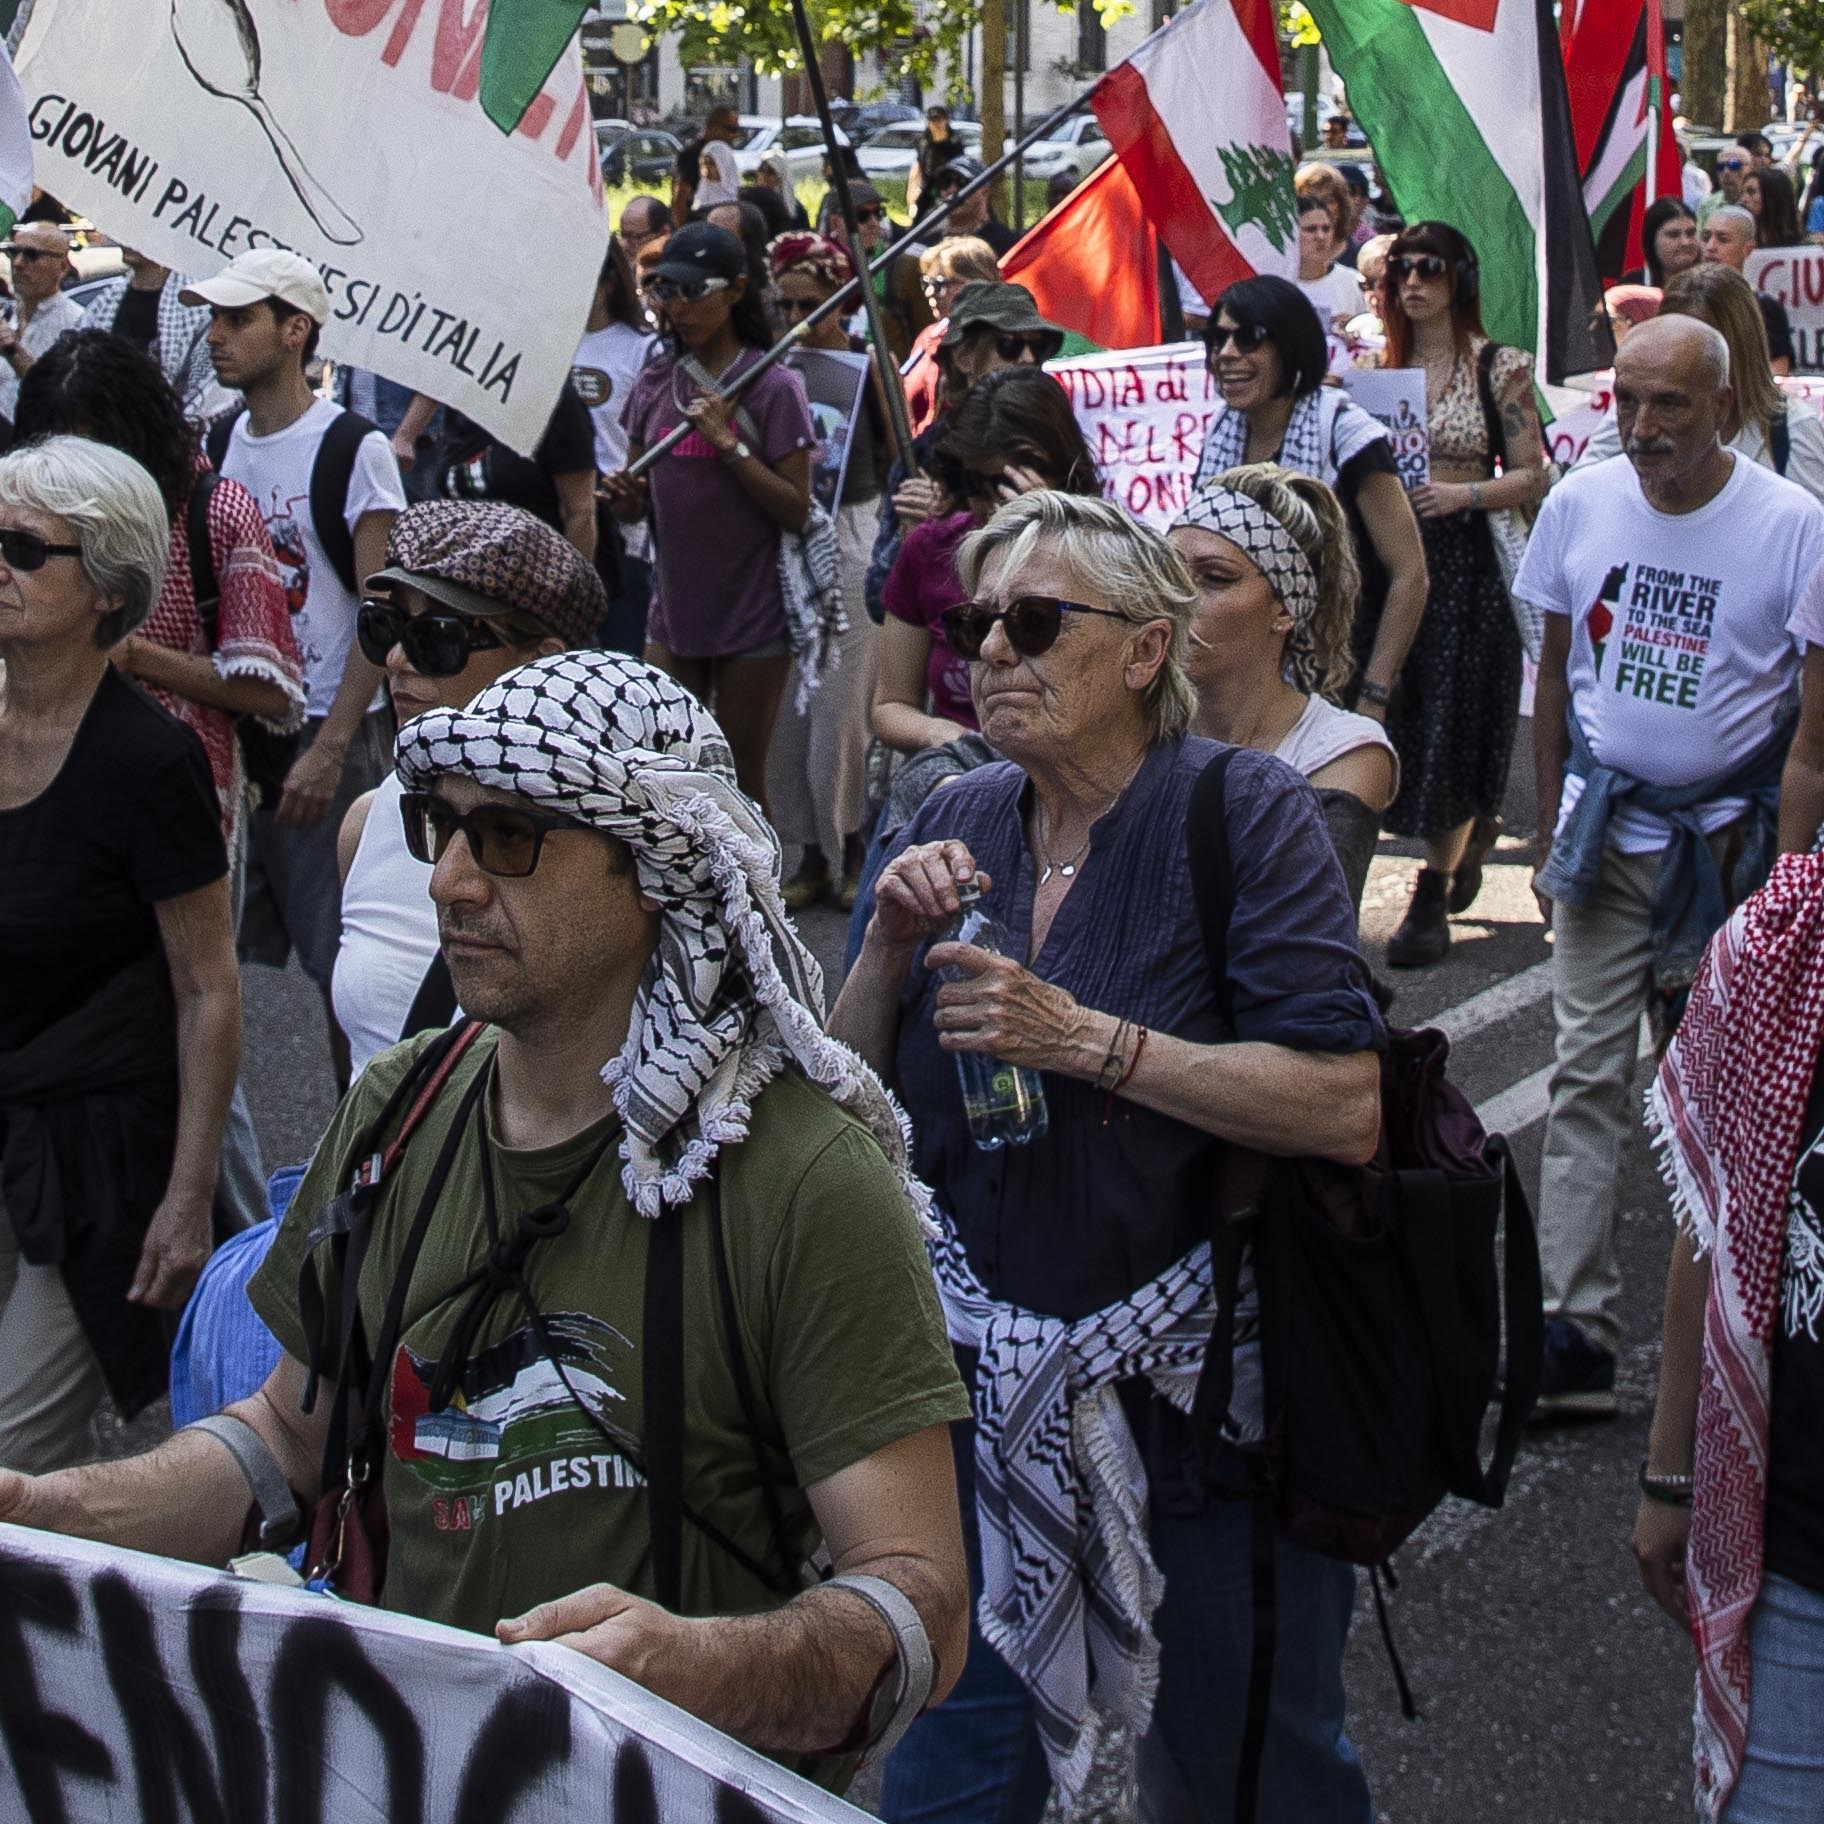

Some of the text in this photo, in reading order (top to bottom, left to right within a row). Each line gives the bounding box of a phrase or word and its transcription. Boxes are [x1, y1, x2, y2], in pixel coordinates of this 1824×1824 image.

[27, 93, 159, 203] GIOVANI
[377, 291, 525, 406] D'ITALIA
[1635, 563, 1722, 597] FROM THE
[1630, 582, 1717, 623] RIVER
[1624, 624, 1710, 655] PALESTINE
[1628, 608, 1712, 639] TO THE SEA
[1621, 641, 1705, 676] WILL BE
[1615, 662, 1701, 710] FREE
[493, 1452, 650, 1517] PALESTIN
